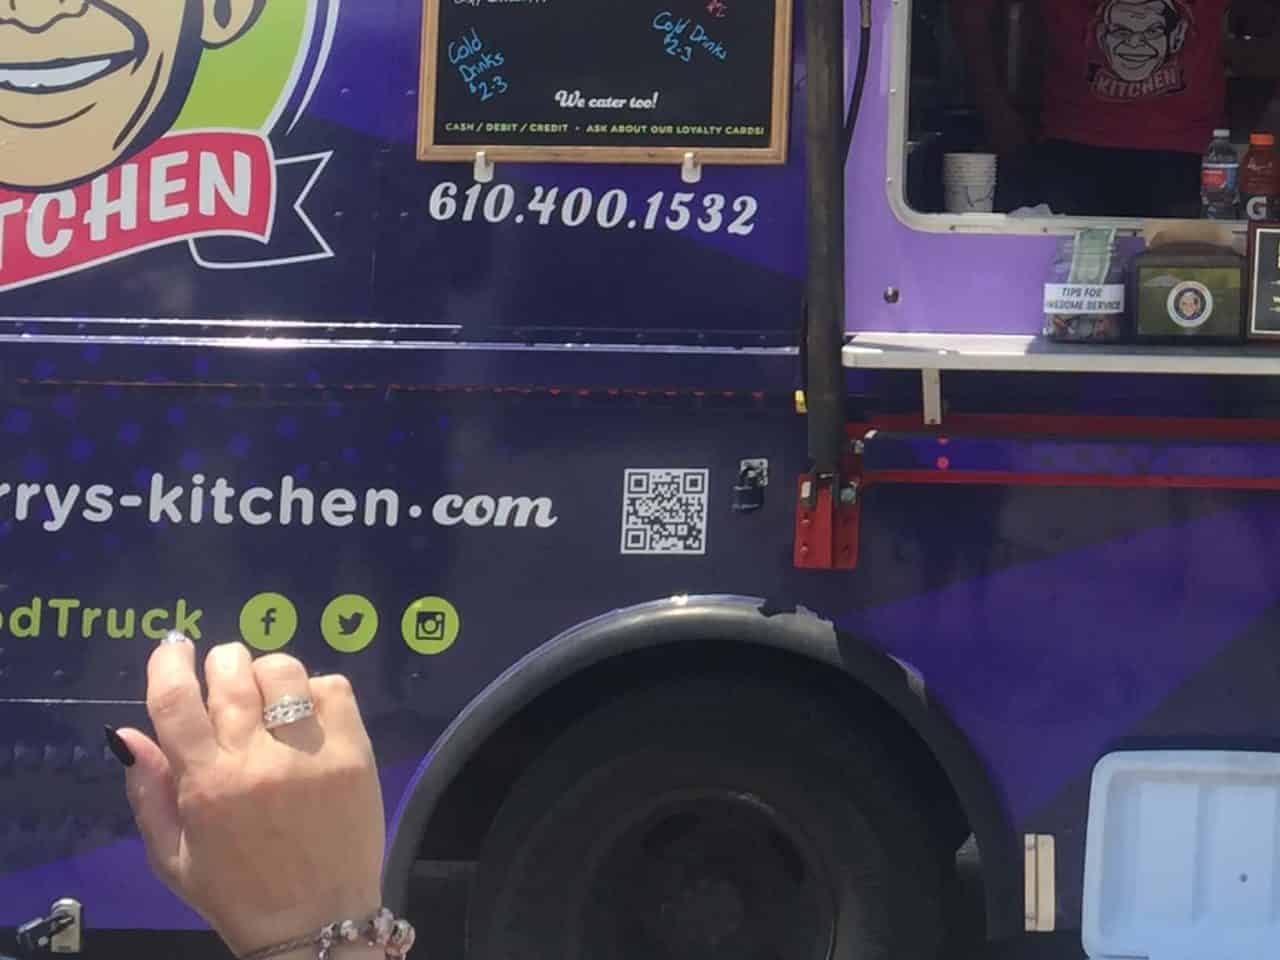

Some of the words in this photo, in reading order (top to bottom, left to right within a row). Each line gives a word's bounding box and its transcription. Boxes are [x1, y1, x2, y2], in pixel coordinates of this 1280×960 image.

[1096, 69, 1180, 98] KITCHEN
[555, 90, 586, 108] We
[588, 95, 627, 109] cater
[630, 91, 659, 109] too!
[445, 123, 474, 132] CASH
[486, 123, 518, 132] DEBIT
[529, 124, 568, 133] CREDIT
[586, 124, 608, 133] ASK
[610, 124, 647, 133] ABOUT
[651, 125, 673, 134] OUR
[676, 125, 722, 135] LOYALTY
[725, 126, 764, 136] CARDS!
[429, 181, 758, 235] 610.400.1532
[1246, 196, 1267, 220] G
[0, 596, 203, 640] dTruck
